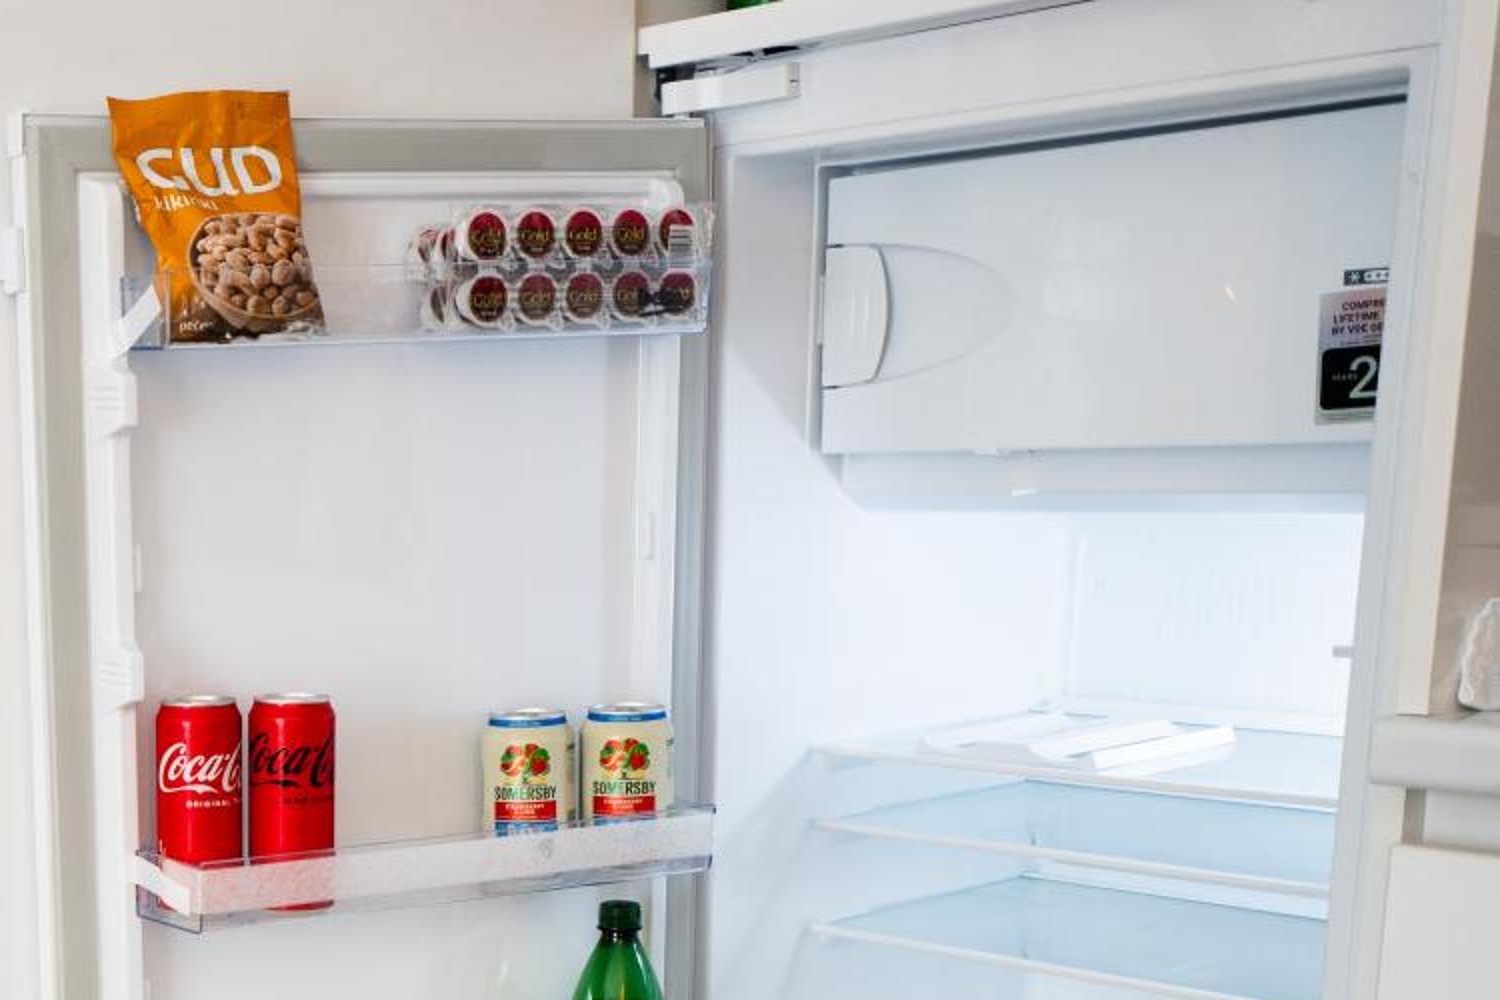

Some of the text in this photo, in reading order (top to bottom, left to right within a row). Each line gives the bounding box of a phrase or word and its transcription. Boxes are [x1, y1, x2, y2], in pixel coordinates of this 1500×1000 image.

[569, 227, 597, 241] Gold
[618, 225, 645, 241] Gold
[1349, 355, 1378, 399] 2
[494, 785, 557, 800] SOMERSBY
[593, 780, 656, 795] SOMERSBY
